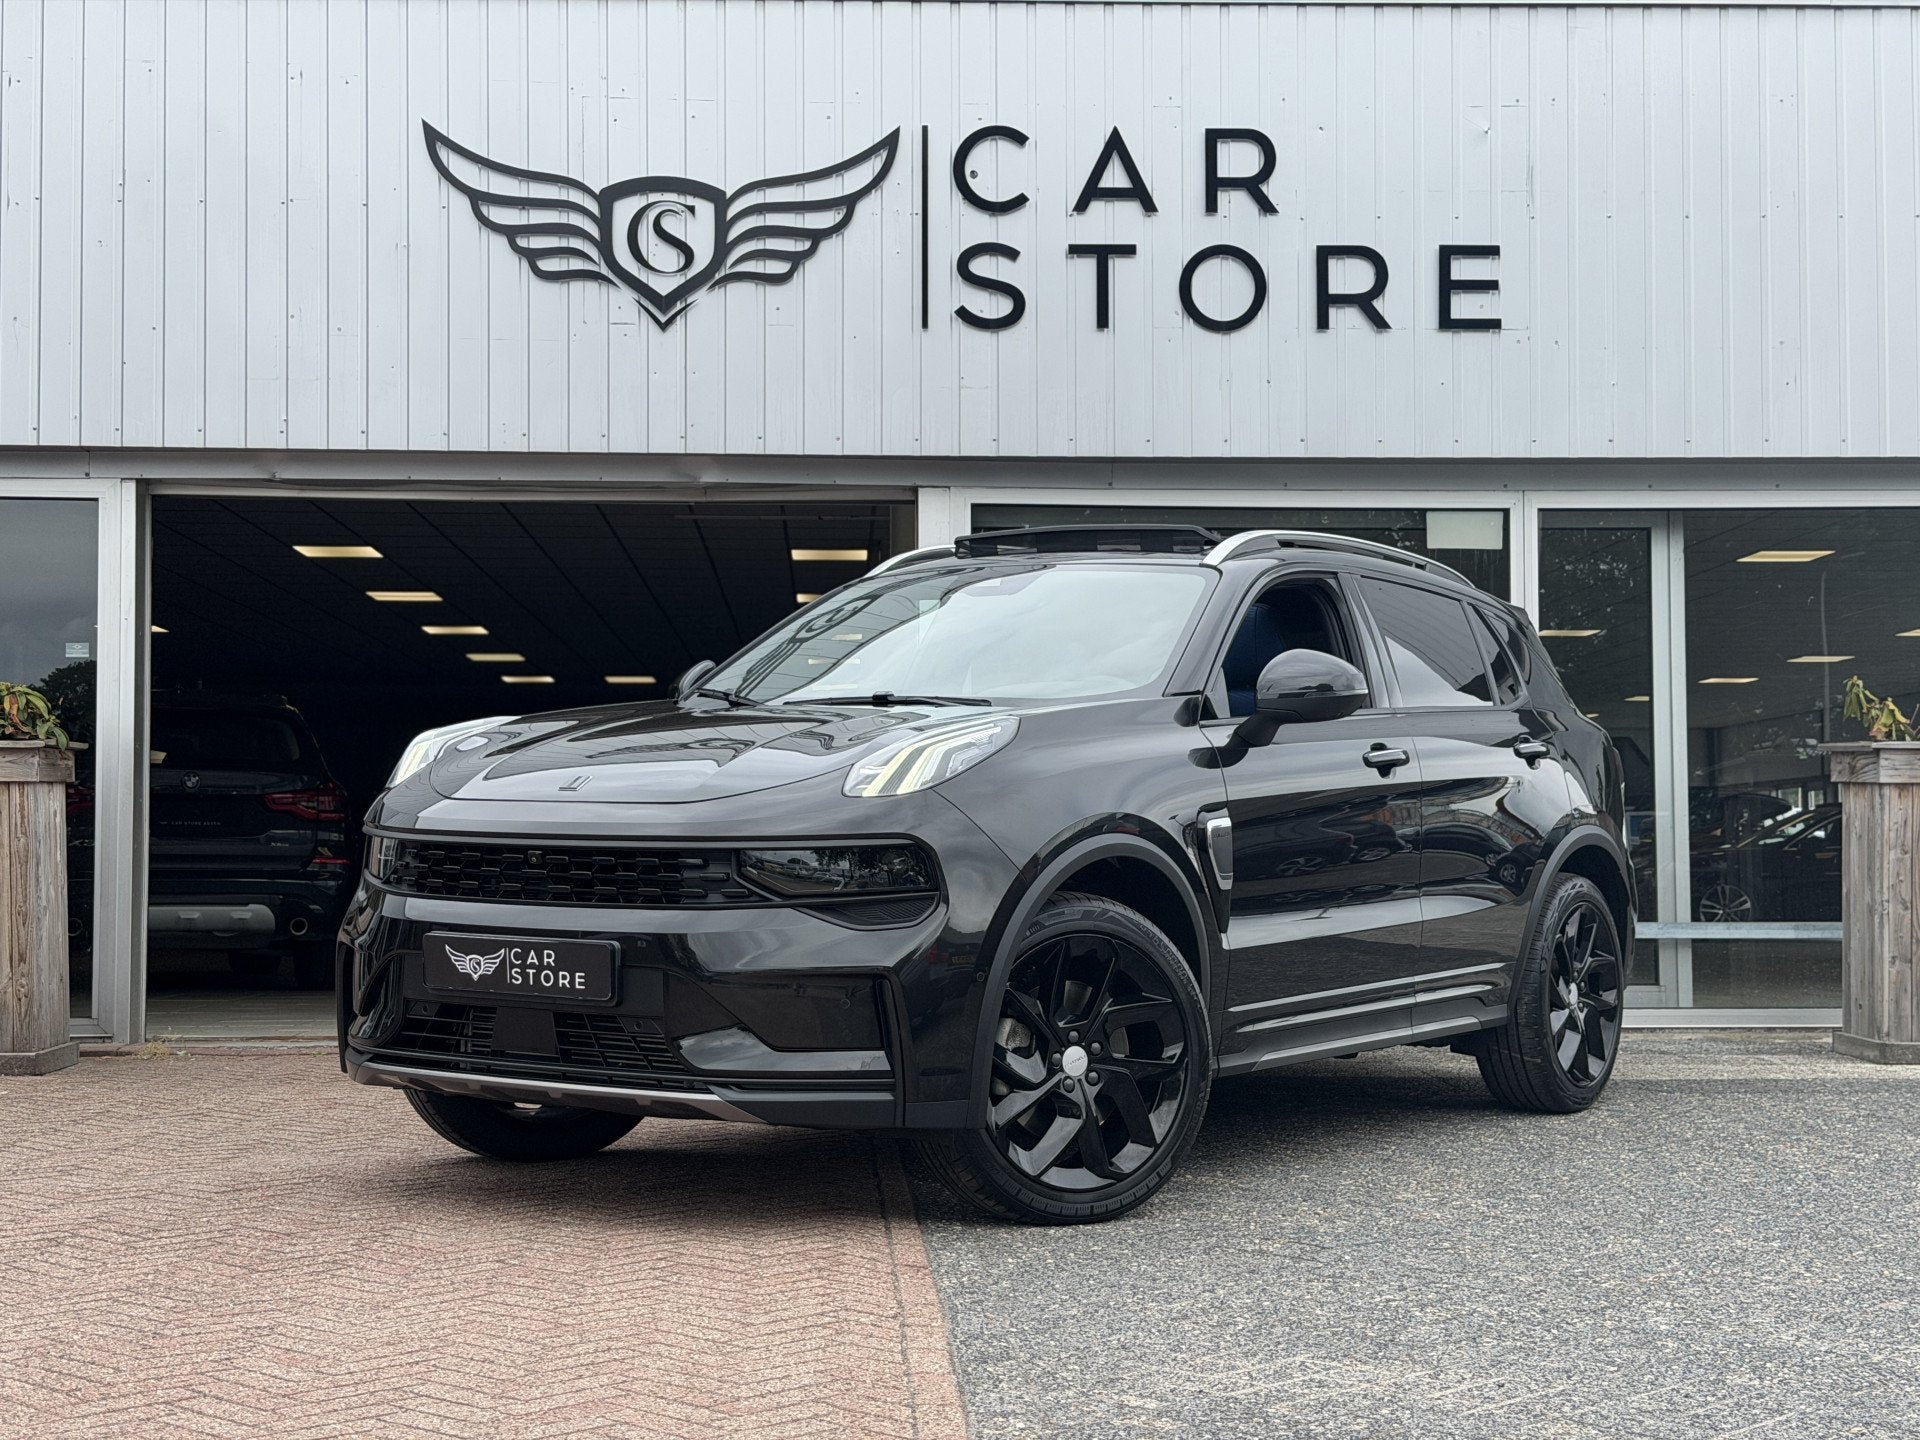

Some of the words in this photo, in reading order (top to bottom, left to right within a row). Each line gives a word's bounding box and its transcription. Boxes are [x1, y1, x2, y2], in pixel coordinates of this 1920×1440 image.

[953, 125, 1280, 216] CAR
[954, 242, 1502, 332] STORE
[510, 948, 555, 966] CAR
[511, 968, 586, 989] STORE
